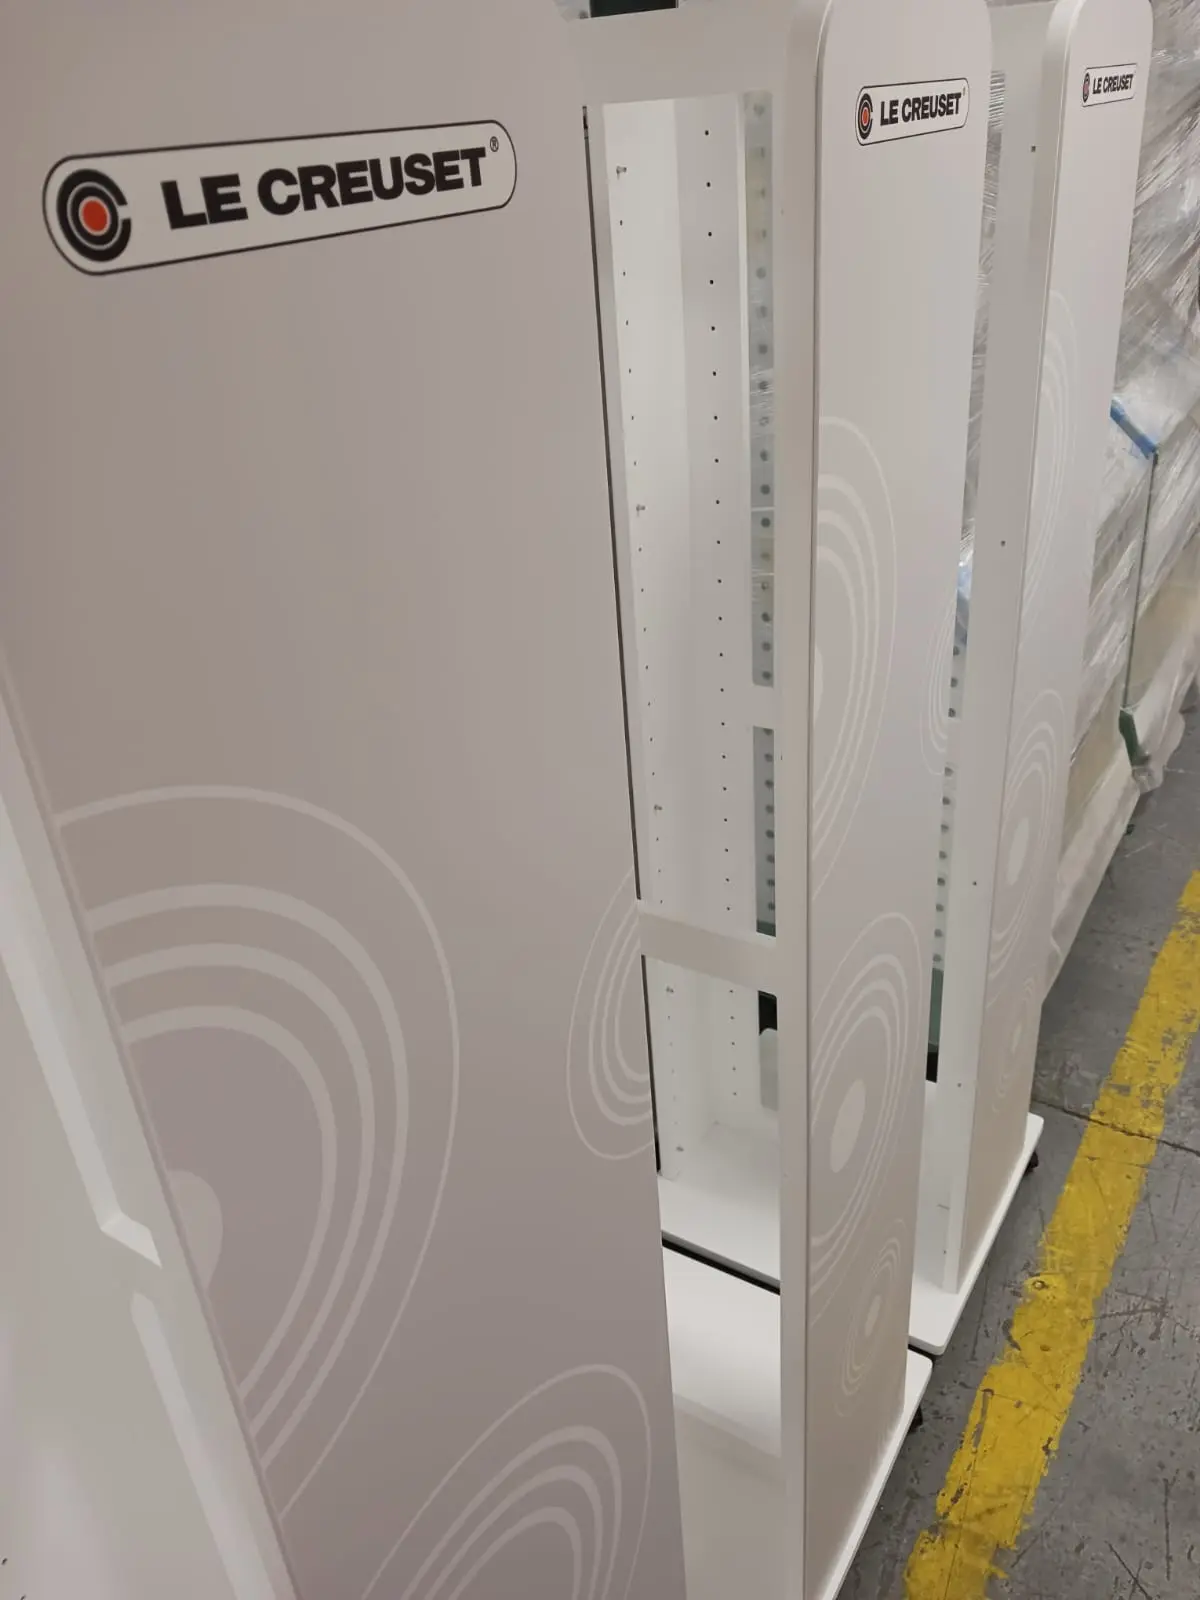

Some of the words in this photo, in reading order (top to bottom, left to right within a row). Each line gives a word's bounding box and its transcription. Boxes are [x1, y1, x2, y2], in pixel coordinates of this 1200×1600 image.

[1092, 77, 1103, 95] LE
[1103, 73, 1134, 93] CREUSET
[880, 100, 899, 126] LE
[161, 173, 249, 230] LE
